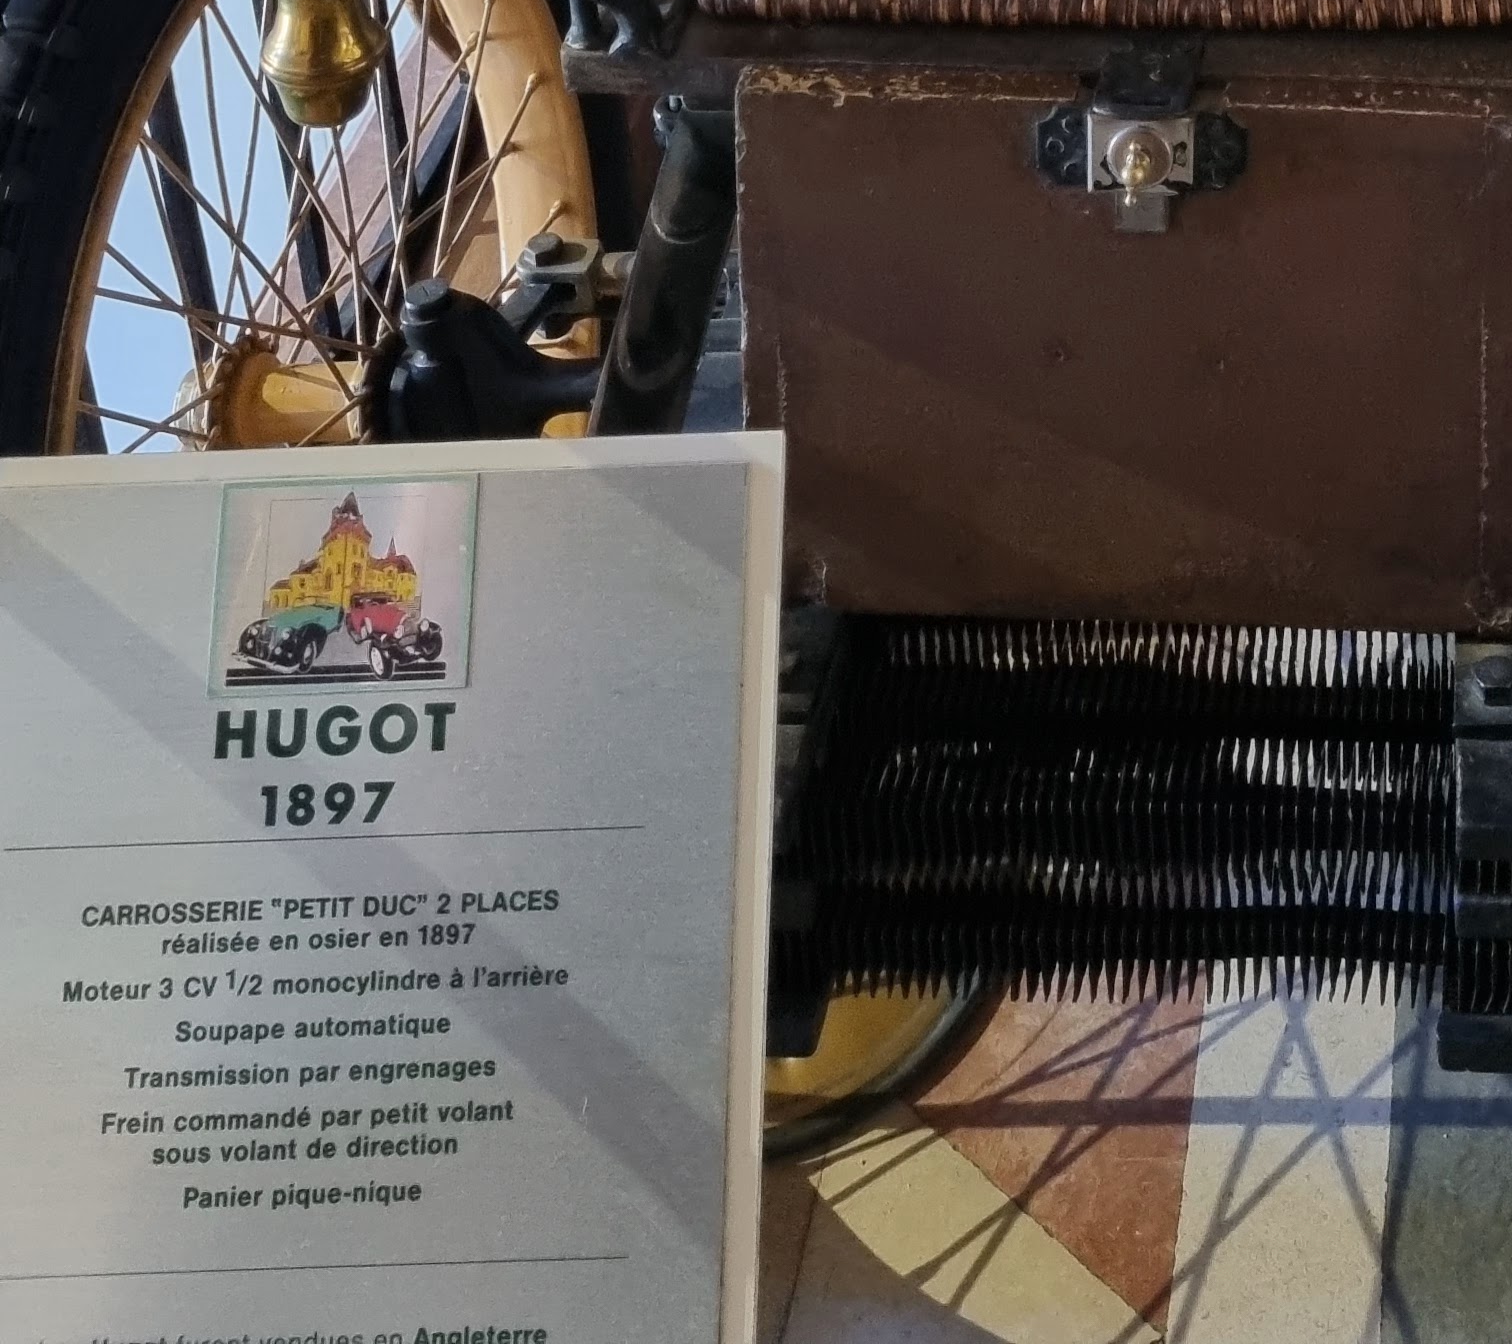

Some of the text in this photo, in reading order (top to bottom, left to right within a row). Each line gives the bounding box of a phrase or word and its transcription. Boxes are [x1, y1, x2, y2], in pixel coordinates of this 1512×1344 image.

[213, 701, 457, 760] HUGOT
[260, 780, 396, 828] 1897
[81, 899, 264, 928] CARROSSERIE
[436, 892, 452, 915] 2
[461, 889, 560, 914] PLACES
[161, 922, 477, 956] réalisée en osier en 1897
[62, 979, 152, 1003] Moteur
[157, 976, 174, 1000] 3
[183, 975, 218, 999] CV
[272, 968, 441, 999] monocylindre
[448, 965, 464, 990] à
[472, 964, 569, 989] l'arrière
[174, 1012, 451, 1046] Soupape automatique
[123, 1059, 496, 1089] Transmission par engrenages
[100, 1099, 514, 1135] Frein commandé par petit volant
[152, 1132, 459, 1167] sous volant de direction
[183, 1179, 423, 1211] Panier pique-nique
